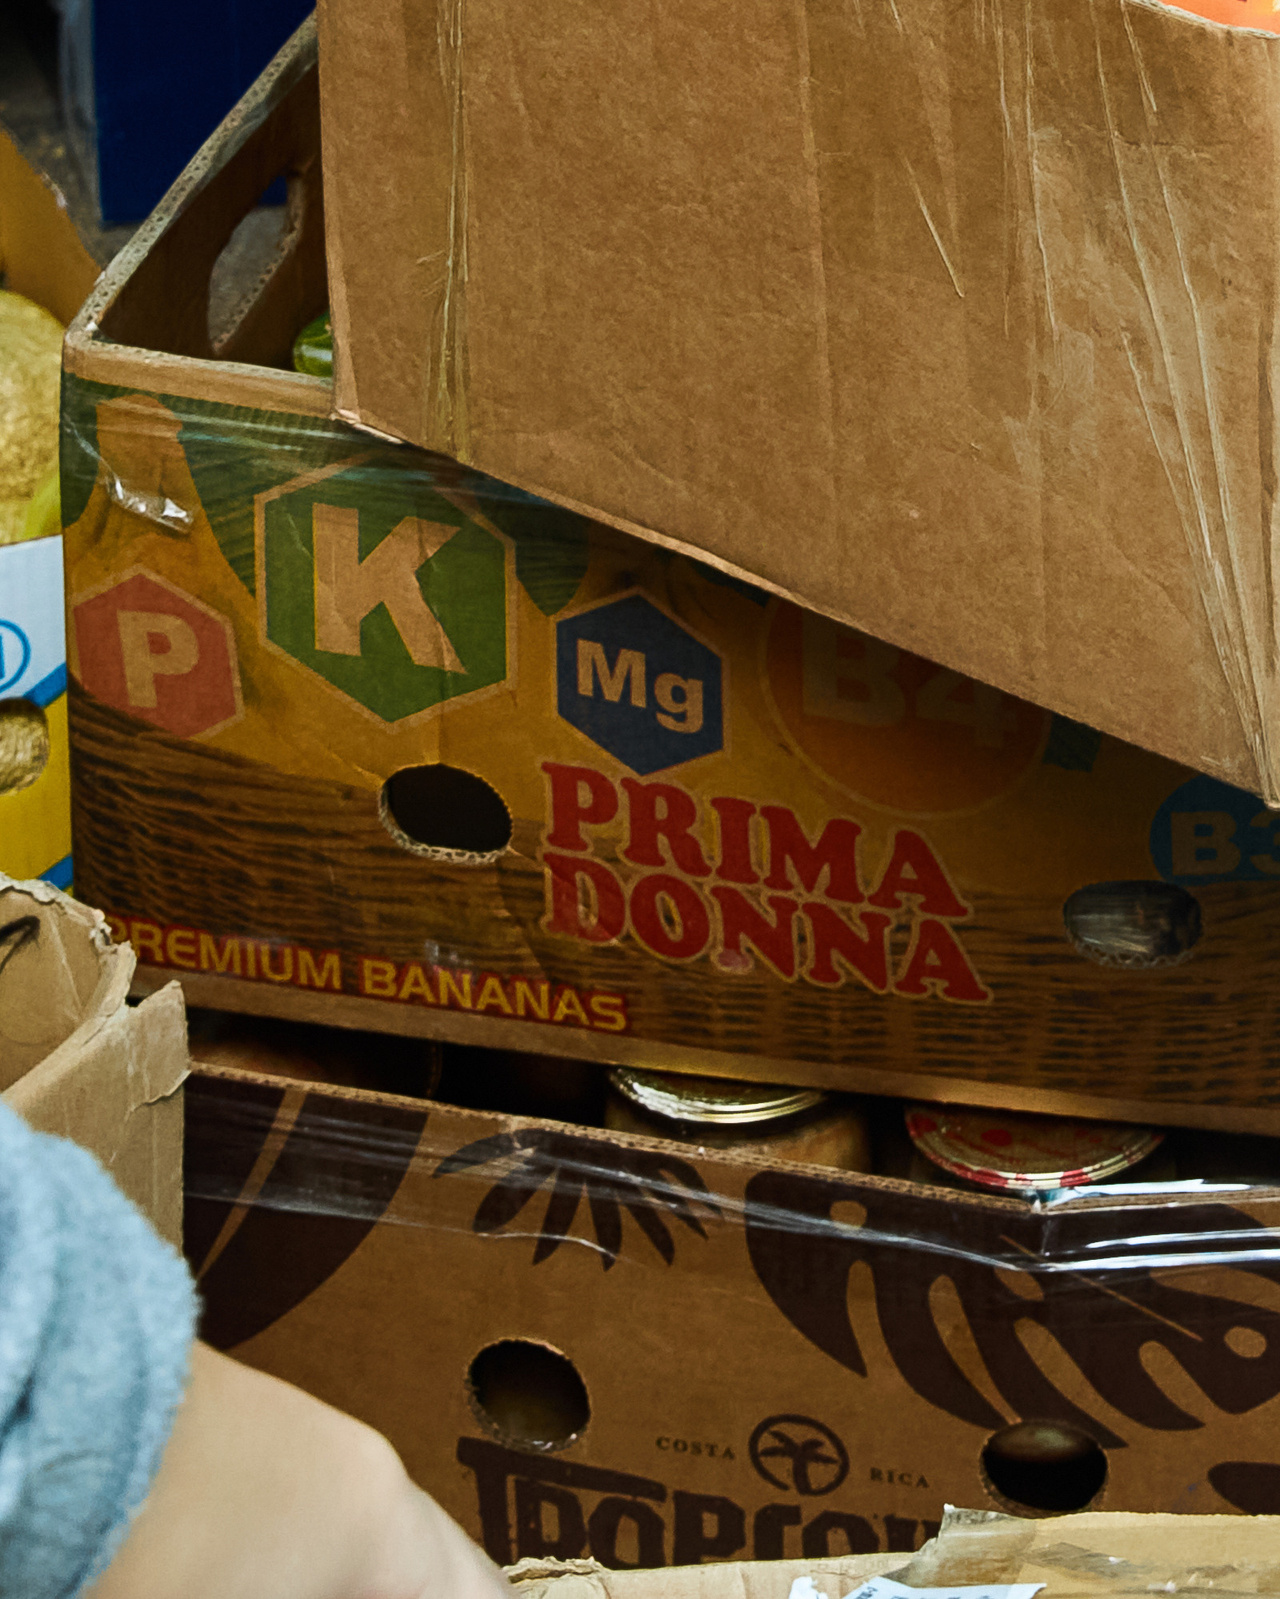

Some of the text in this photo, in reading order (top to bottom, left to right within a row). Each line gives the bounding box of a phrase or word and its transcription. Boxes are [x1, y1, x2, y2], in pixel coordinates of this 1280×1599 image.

[311, 502, 468, 676] K
[115, 610, 201, 709] P
[576, 639, 704, 735] Mg
[541, 761, 970, 918] PRIMA
[108, 921, 627, 1032] PREMIUM BANANAS
[543, 853, 990, 1001] DONNA
[655, 1434, 931, 1490] COSTA RICA
